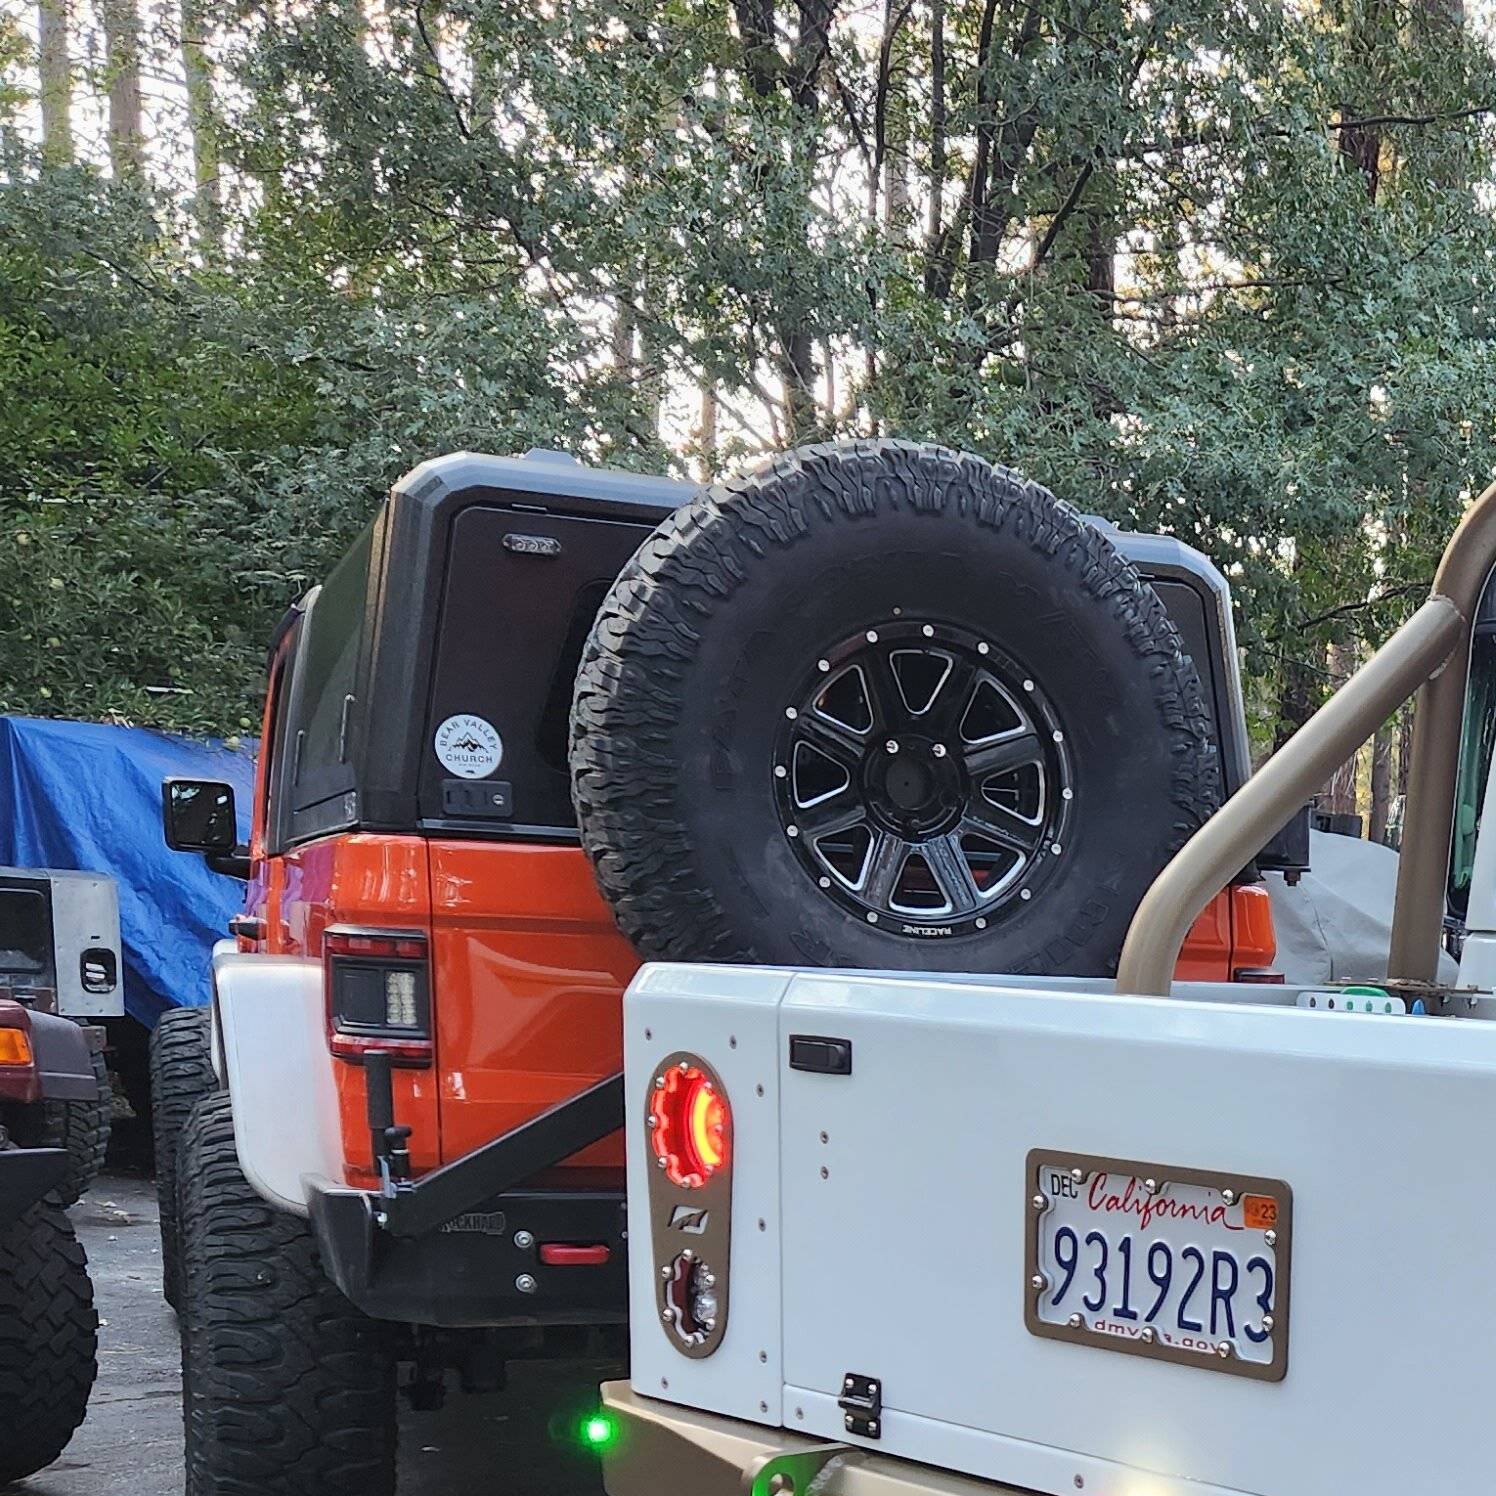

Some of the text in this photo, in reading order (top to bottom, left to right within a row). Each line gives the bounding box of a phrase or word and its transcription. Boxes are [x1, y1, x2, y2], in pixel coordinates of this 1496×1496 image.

[464, 719, 498, 750] VALLEY
[446, 754, 493, 763] CHURCH
[1051, 1173, 1079, 1199] DEC
[1088, 1172, 1245, 1231] California
[1260, 1203, 1277, 1221] 23
[1051, 1226, 1274, 1343] 93192R3
